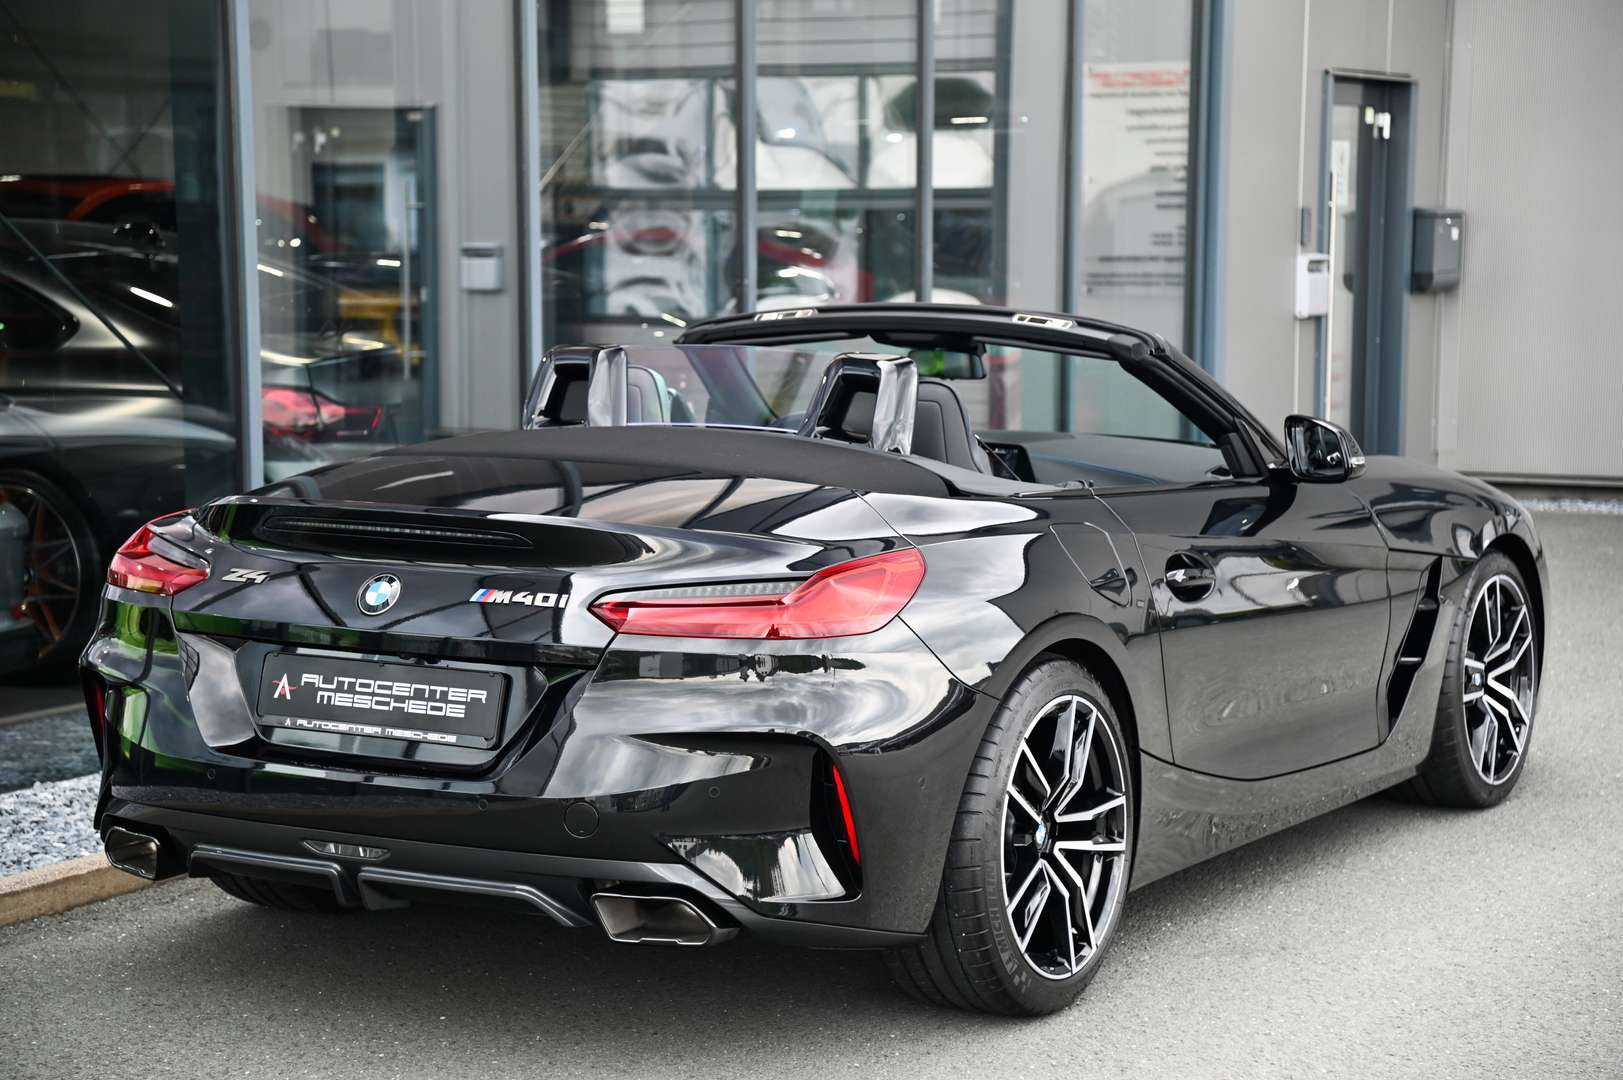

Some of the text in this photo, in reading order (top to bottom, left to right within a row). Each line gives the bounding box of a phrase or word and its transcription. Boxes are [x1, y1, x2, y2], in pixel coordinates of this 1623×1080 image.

[222, 568, 271, 584] Z4
[491, 590, 569, 609] M40i
[301, 673, 488, 704] AUTOCENTER
[316, 691, 466, 718] MESCHEDE
[297, 719, 381, 735] AUTOCENTER
[385, 728, 457, 743] MESCHEDE
